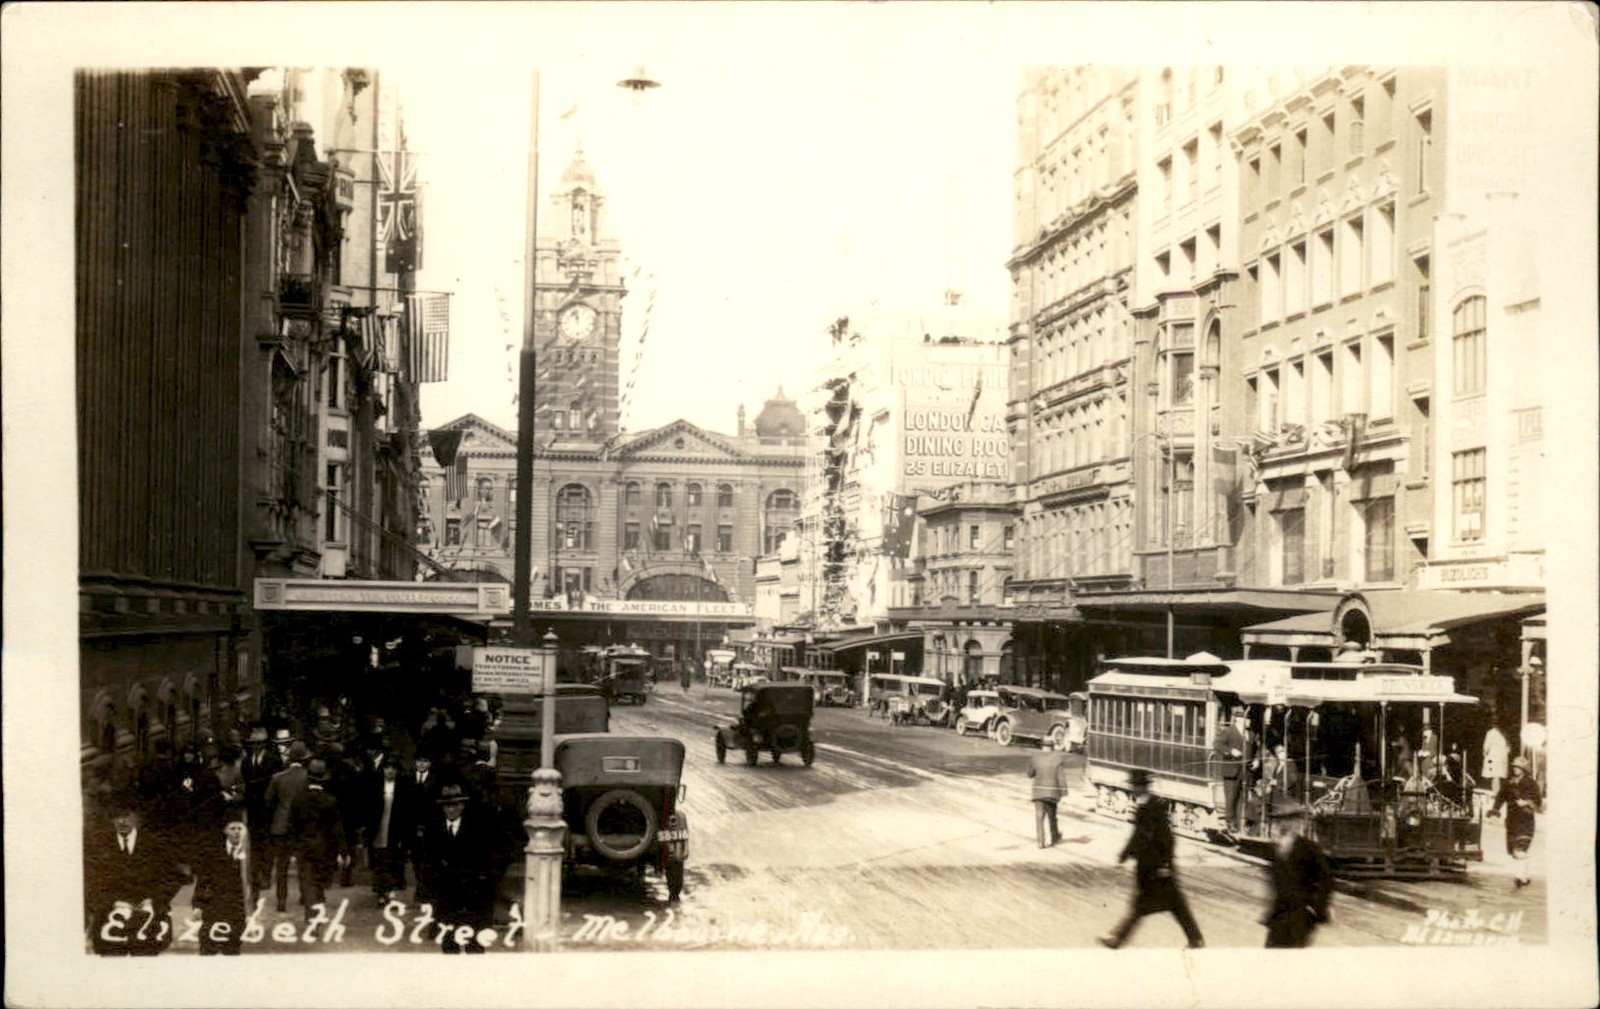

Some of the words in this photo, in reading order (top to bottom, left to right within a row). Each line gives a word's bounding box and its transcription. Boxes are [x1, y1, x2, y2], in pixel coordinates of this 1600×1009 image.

[904, 410, 974, 433] LONDON
[905, 436, 965, 457] DINING
[905, 461, 927, 476] 25
[590, 602, 612, 611] THE
[622, 603, 687, 613] AMERICAN
[697, 604, 736, 614] FLEET
[485, 654, 531, 664] NOTICE
